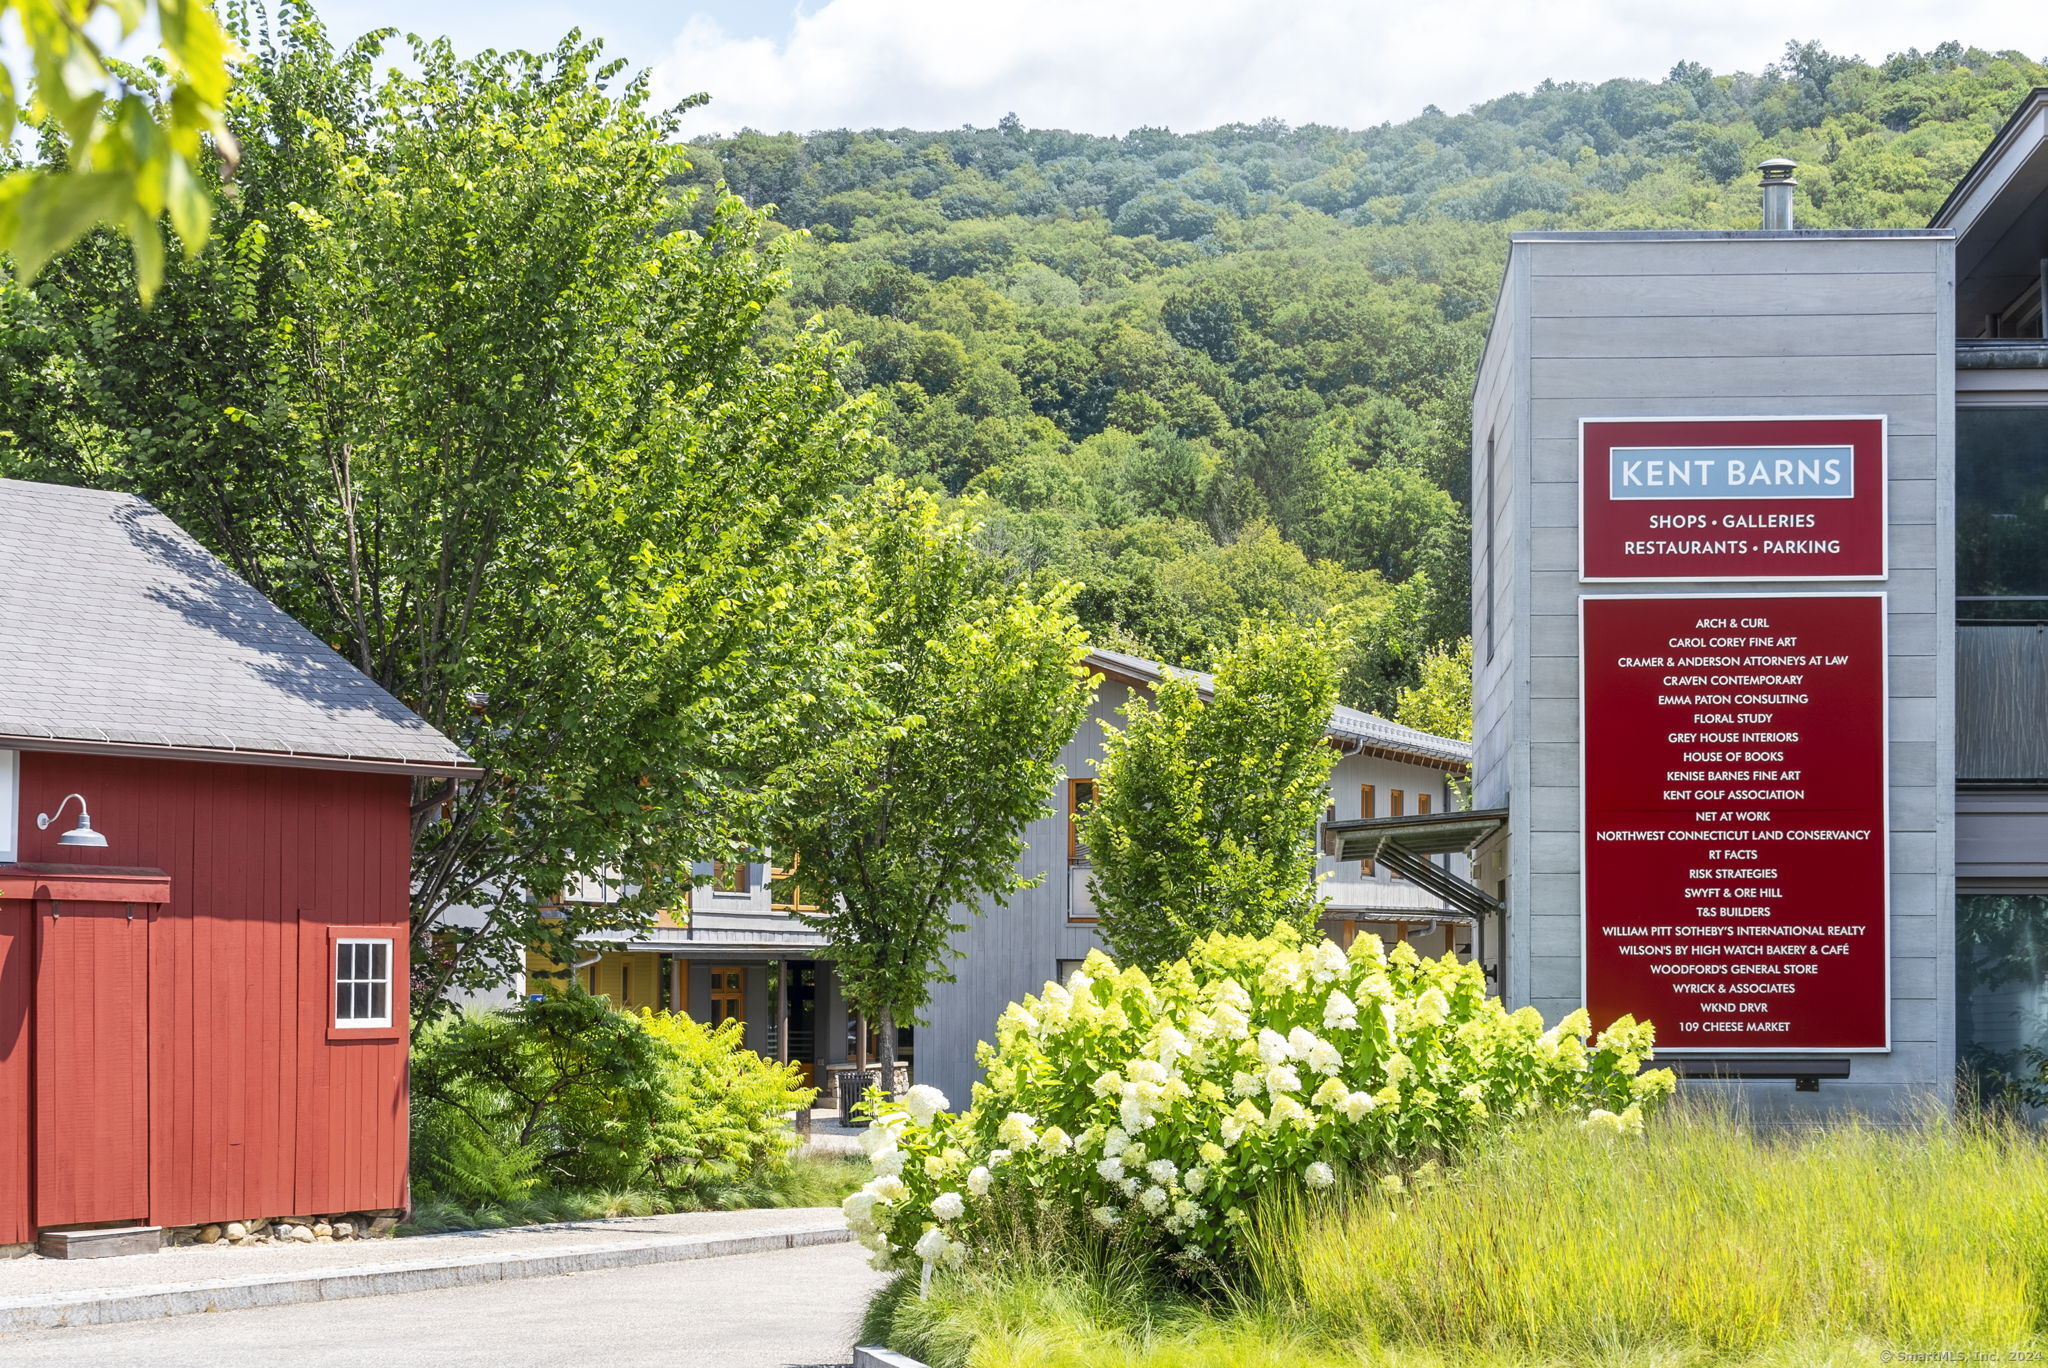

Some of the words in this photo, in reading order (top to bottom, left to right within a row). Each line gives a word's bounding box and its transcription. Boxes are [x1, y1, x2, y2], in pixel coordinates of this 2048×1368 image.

[1623, 460, 1714, 486] KENT
[1728, 459, 1840, 485] BARNS
[1650, 515, 1706, 528] SHOPS
[1723, 514, 1814, 528] GALLERIES
[1625, 541, 1747, 554] RESTAURANTS
[1764, 540, 1840, 553] PARKING
[1696, 619, 1726, 628] ARCH
[1730, 619, 1737, 628] &
[1741, 618, 1769, 628] CURL
[1669, 638, 1706, 648] CAROL
[1709, 638, 1746, 647] COREY
[1750, 637, 1773, 646] FINE
[1776, 637, 1797, 646] ART
[1618, 657, 1664, 667] CRAMER
[1667, 657, 1674, 666] &
[1678, 657, 1740, 666] ANDERSON
[1743, 656, 1806, 666] ATTORNEYS
[1809, 656, 1822, 665] AT
[1826, 656, 1848, 665] LAW
[1663, 676, 1707, 686] CRAVEN
[1711, 675, 1803, 685] CONTEMPORARY
[1659, 696, 1692, 705] EMMA
[1695, 695, 1731, 704] PATON
[1734, 694, 1808, 704] CONSULTING
[1694, 714, 1734, 723] FLORAL
[1737, 714, 1772, 723] STUDY
[1668, 733, 1697, 743] GREY
[1700, 733, 1739, 742] HOUSE
[1742, 732, 1798, 742] INTERIORS
[1684, 752, 1722, 762] HOUSE
[1726, 752, 1742, 761] OF
[1745, 752, 1784, 761] BOOKS
[1667, 771, 1704, 781] KENISE
[1708, 771, 1750, 780] BARNES
[1753, 771, 1777, 780] FINE
[1780, 771, 1800, 780] ART
[1664, 790, 1692, 800] KENT
[1694, 790, 1725, 800] GOLF
[1728, 790, 1804, 800] ASSOCIATION
[1696, 812, 1717, 821] NET
[1720, 812, 1733, 821] AT
[1736, 812, 1770, 821] WORK
[1597, 831, 1665, 841] NORTHWEST
[1668, 831, 1749, 840] CONNECTICUT
[1752, 831, 1783, 840] LAND
[1786, 830, 1870, 840] CONSERVANCY
[1709, 850, 1722, 859] RT
[1725, 850, 1758, 859] FACTS
[1690, 869, 1712, 878] RISK
[1716, 869, 1778, 878] STRATEGIES
[1685, 888, 1720, 898] SWYFT
[1723, 888, 1731, 898] &
[1734, 888, 1756, 898] ORE
[1760, 888, 1782, 897] HILL
[1696, 907, 1716, 917] T&S
[1720, 907, 1770, 916] BUILDERS
[1602, 927, 1648, 936] WILLIAM
[1651, 926, 1672, 936] PITT
[1737, 926, 1824, 936] INTERNATIONAL
[1828, 926, 1865, 935] REALTY
[1619, 946, 1672, 955] WILSON'S
[1675, 946, 1688, 955] BY
[1692, 946, 1720, 955] HIGH
[1724, 945, 1763, 955] WATCH
[1767, 945, 1807, 954] BAKERY
[1810, 946, 1818, 955] &
[1821, 943, 1848, 954] CAFÉ
[1650, 965, 1728, 974] WOODFORD'S
[1731, 965, 1781, 974] GENERAL
[1784, 964, 1818, 974] STORE
[1673, 984, 1715, 993] WYRICK
[1718, 984, 1726, 993] &
[1729, 984, 1795, 993] ASSOCIATES
[1700, 1003, 1736, 1012] WKND
[1740, 1003, 1768, 1012] DRVR
[1680, 1022, 1699, 1031] 109
[1703, 1022, 1743, 1032] CHEESE
[1746, 1022, 1790, 1031] MARKET
